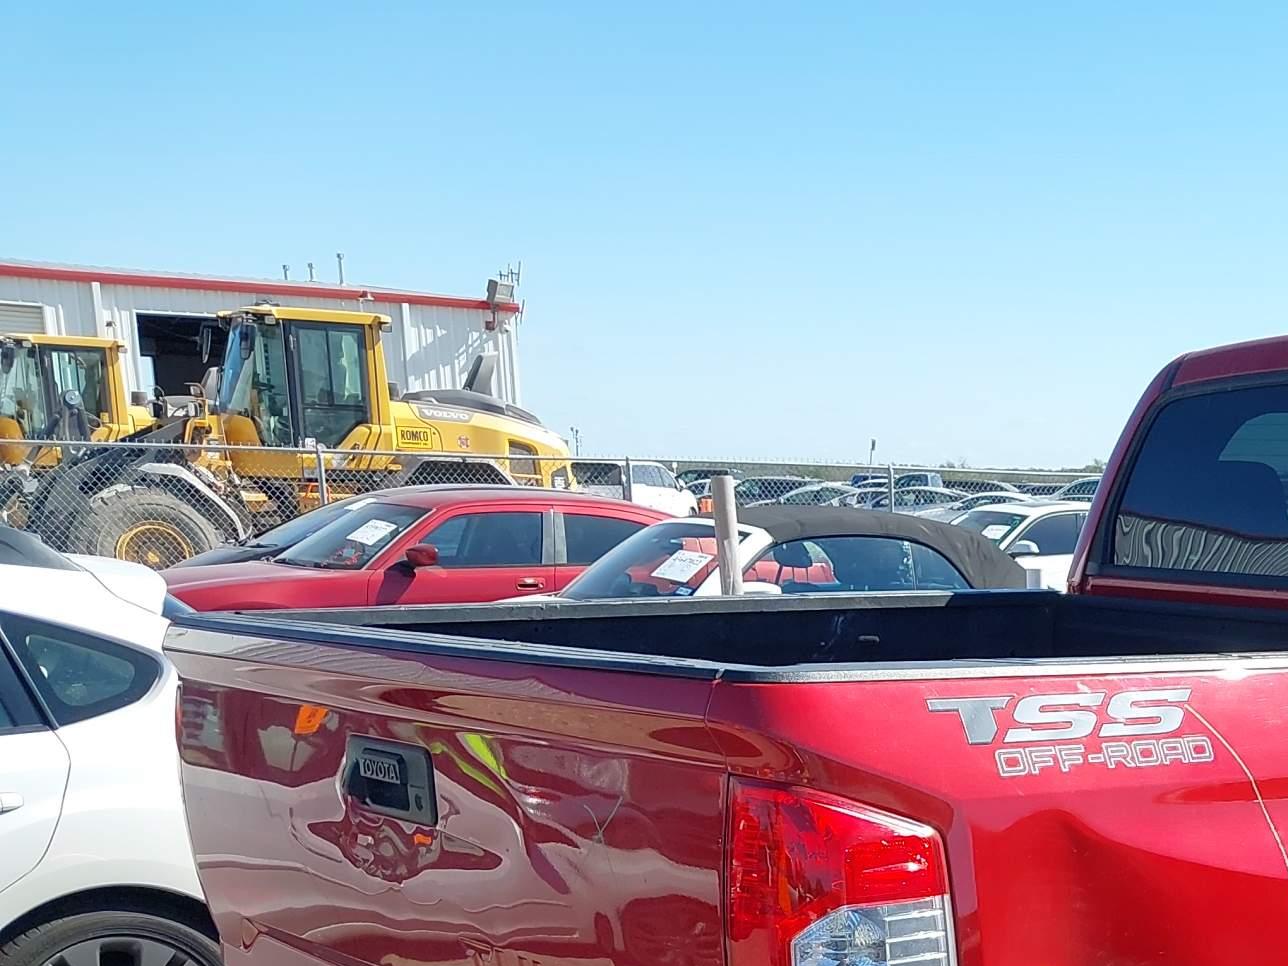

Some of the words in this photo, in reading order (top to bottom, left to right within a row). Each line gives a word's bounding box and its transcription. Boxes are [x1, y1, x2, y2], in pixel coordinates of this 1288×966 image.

[422, 409, 470, 420] VOLVO
[401, 429, 429, 441] ROMCO
[925, 687, 1192, 745] TSS
[995, 735, 1214, 776] OFF-ROAD
[360, 759, 400, 784] TOYOTA
